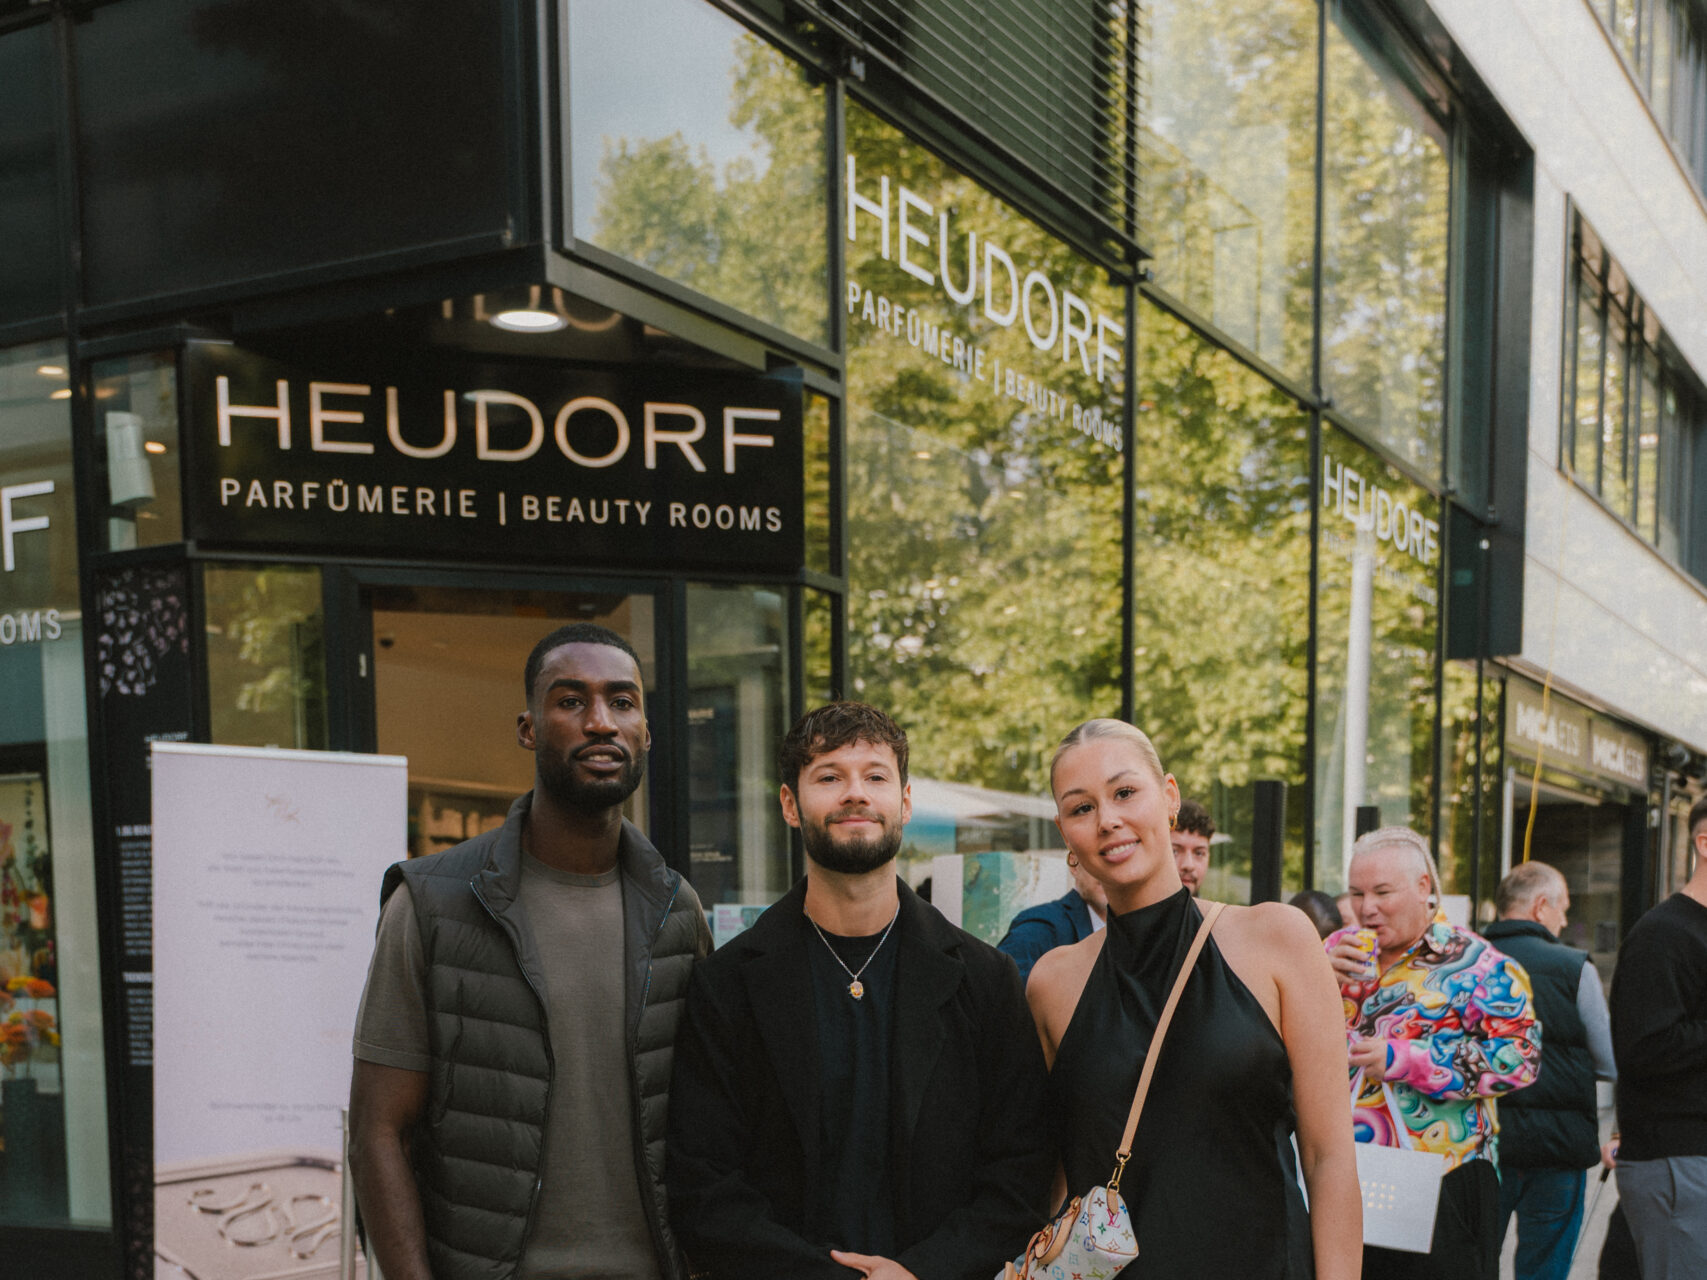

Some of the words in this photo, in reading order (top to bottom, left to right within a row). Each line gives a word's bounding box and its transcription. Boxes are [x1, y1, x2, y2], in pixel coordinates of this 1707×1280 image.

[846, 153, 1124, 383] HEUDORF
[216, 375, 781, 474] HEUDORF
[1005, 367, 1067, 421] BEAUTY
[1072, 403, 1123, 452] ROOMS
[220, 478, 478, 518] PARFÜMERIE
[522, 495, 651, 526] BEAUTY
[669, 503, 782, 532] ROOMS
[1323, 455, 1440, 565] HEUDORF
